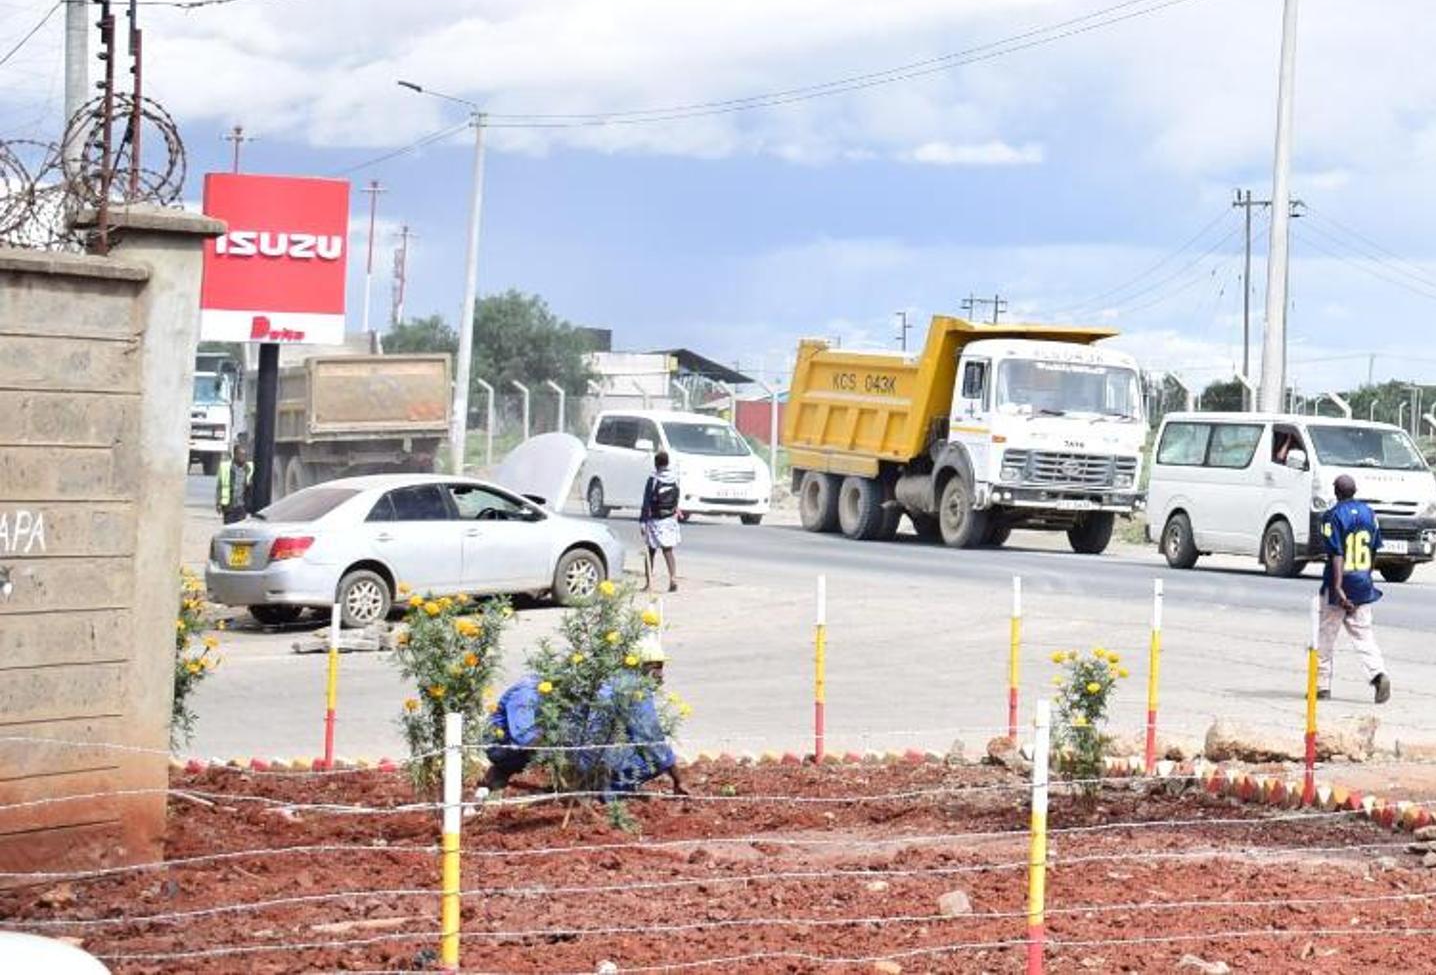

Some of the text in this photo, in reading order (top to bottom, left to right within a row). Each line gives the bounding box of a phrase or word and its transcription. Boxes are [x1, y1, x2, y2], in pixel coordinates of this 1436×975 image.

[215, 231, 342, 260] ISUZU
[832, 372, 896, 396] KCS 043K
[1344, 530, 1371, 572] 16
